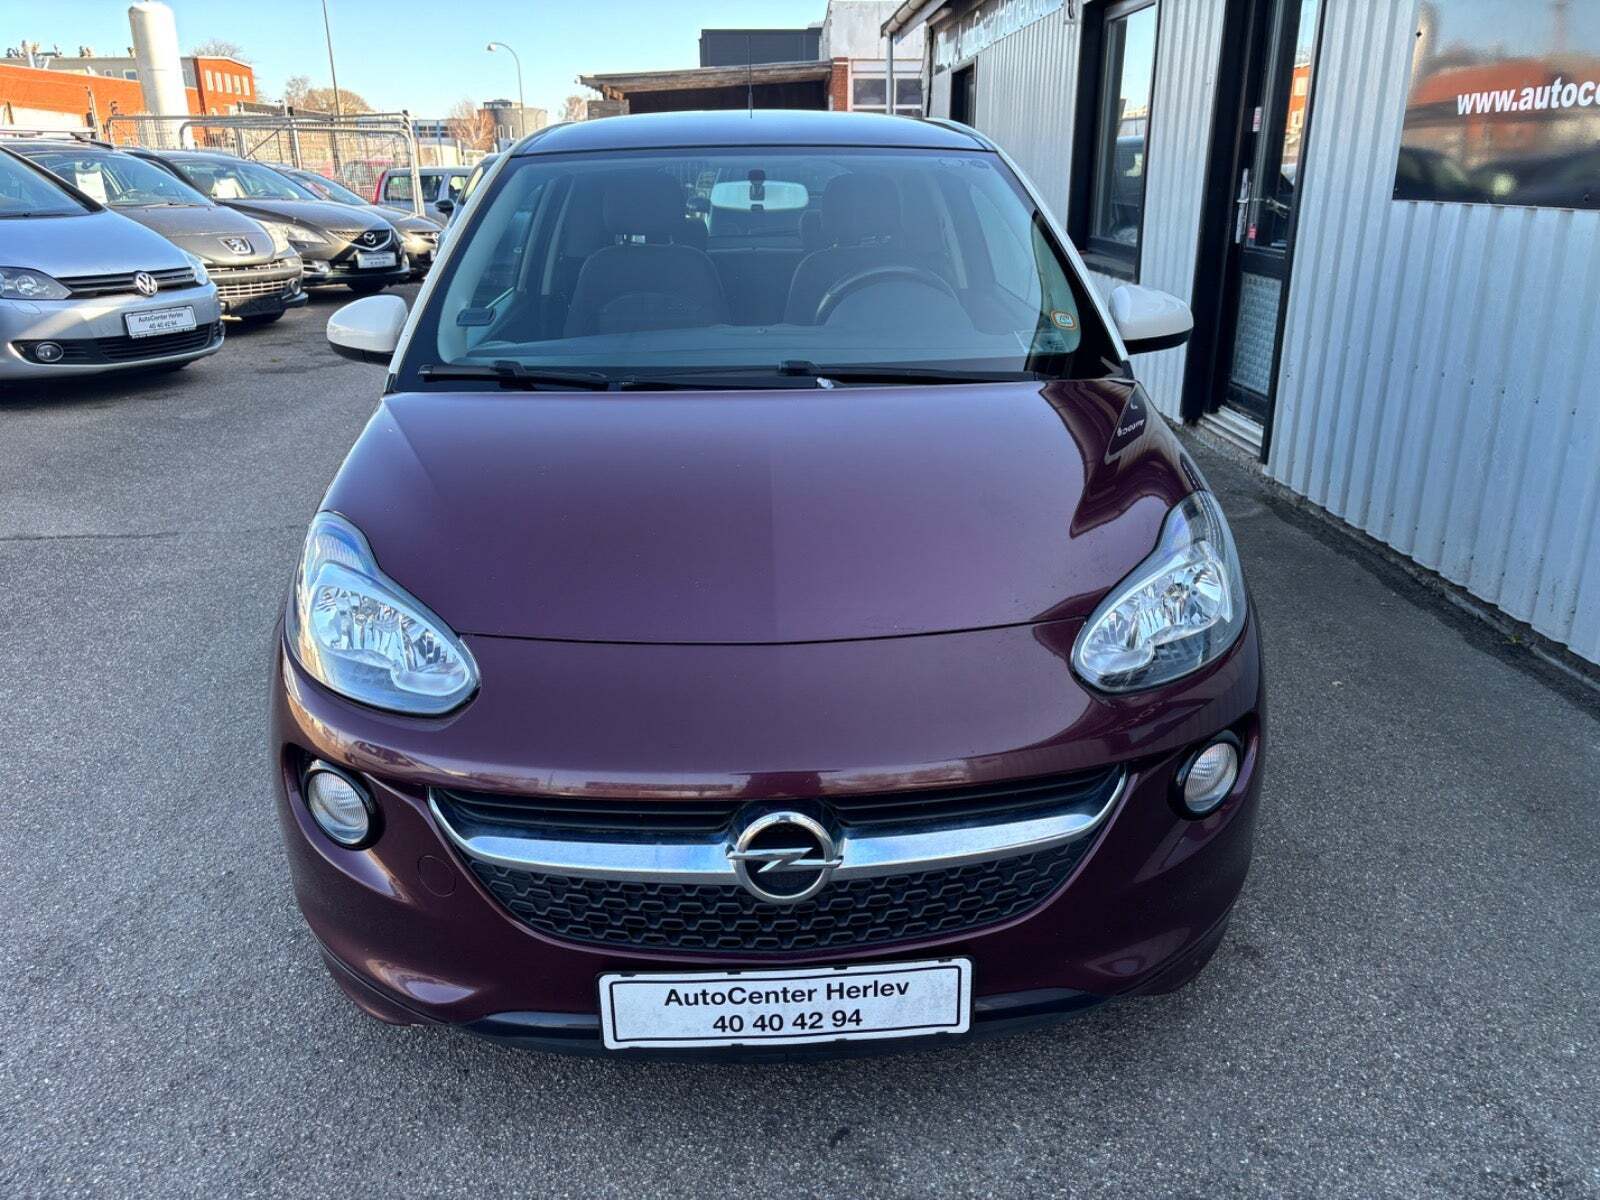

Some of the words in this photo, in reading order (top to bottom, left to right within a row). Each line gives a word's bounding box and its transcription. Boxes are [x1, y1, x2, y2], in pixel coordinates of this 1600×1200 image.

[664, 986, 818, 1007] AutoCenter
[826, 980, 910, 1001] Herlev
[713, 1014, 744, 1033] 40
[752, 1013, 784, 1032] 40
[792, 1011, 824, 1030] 42
[831, 1008, 863, 1027] 94
